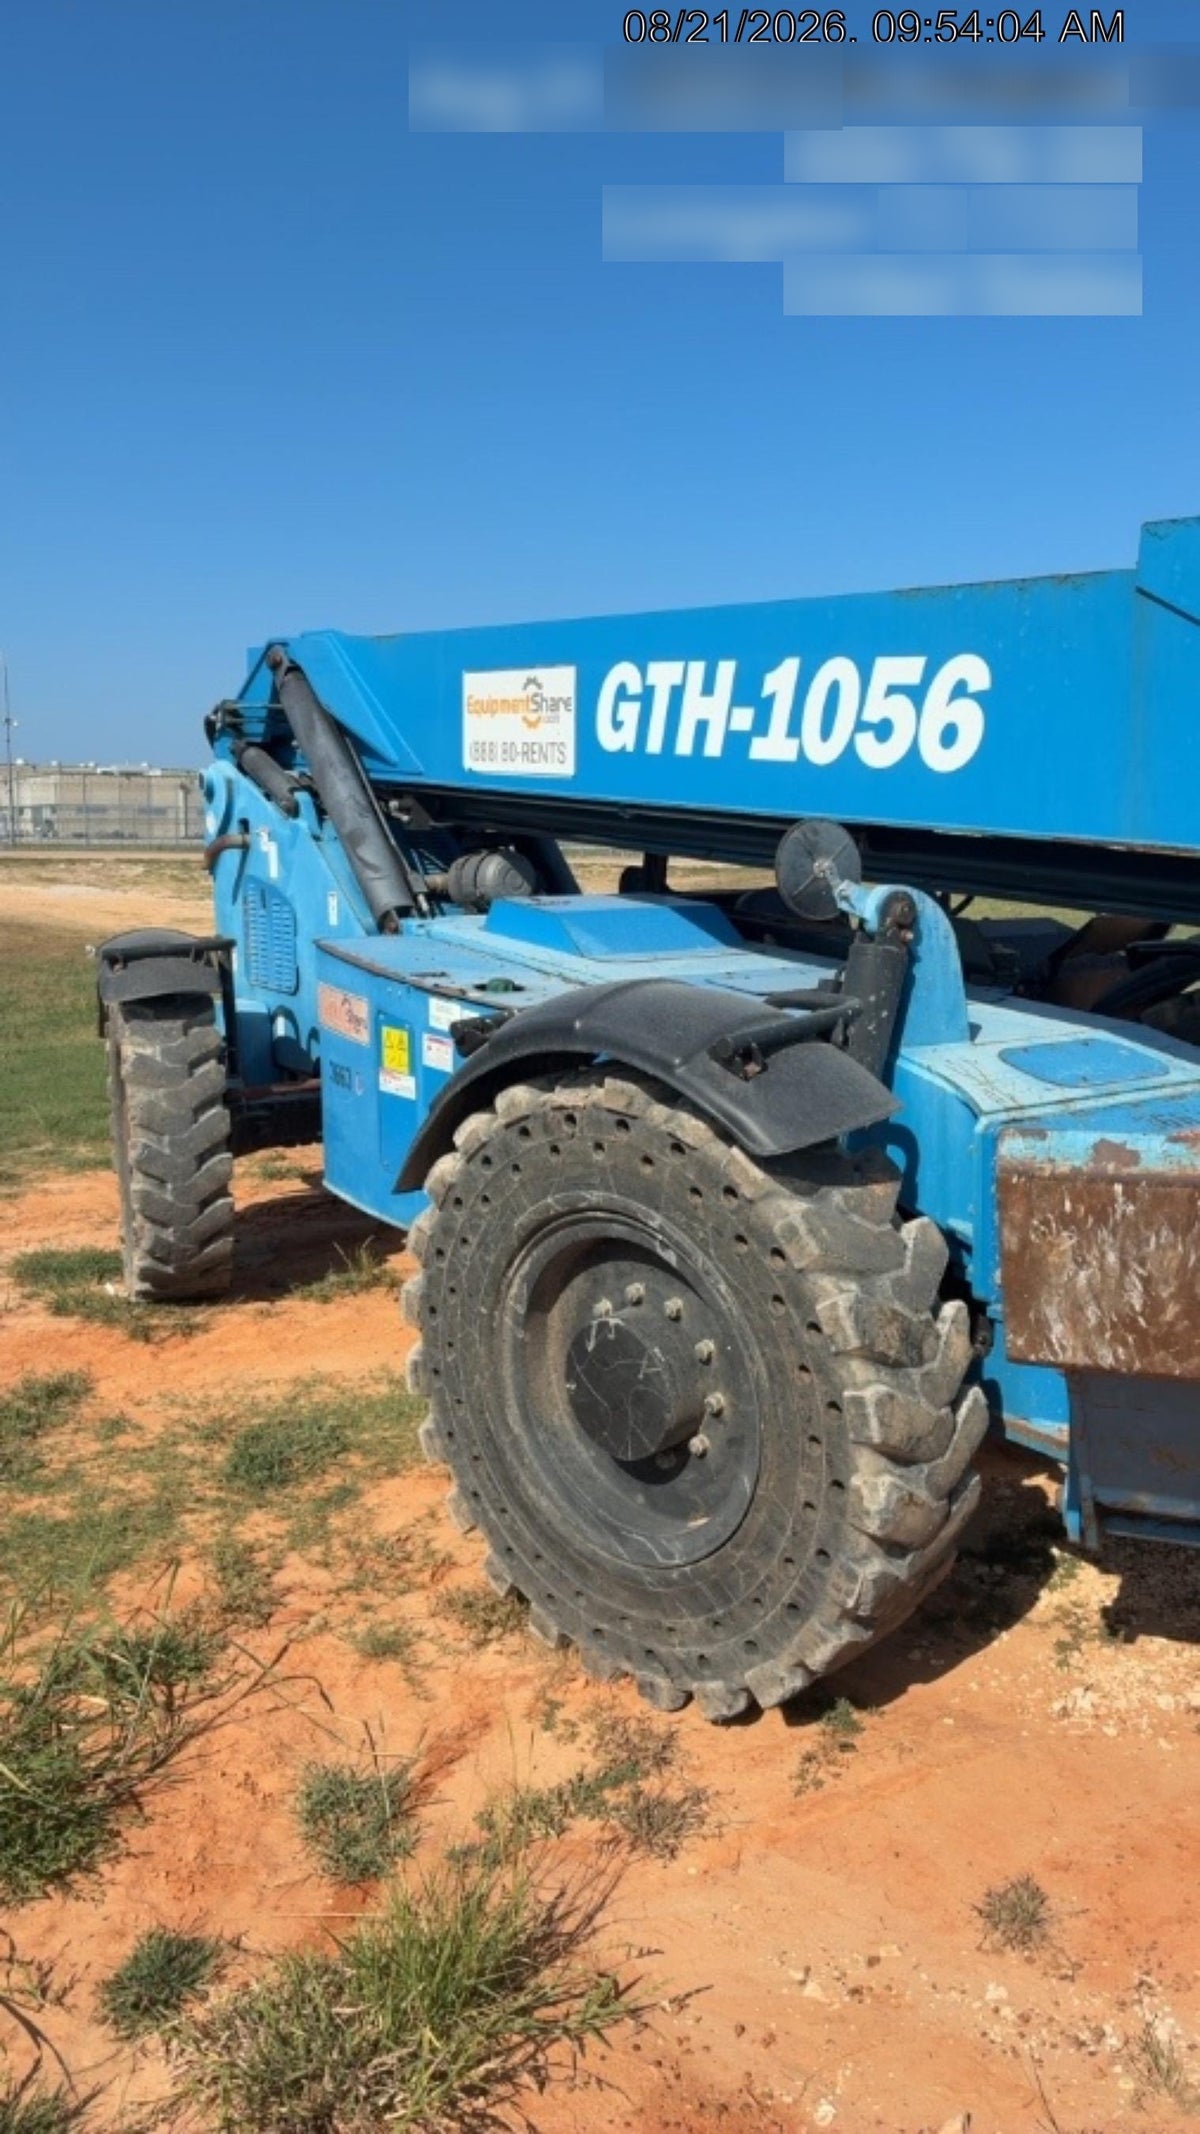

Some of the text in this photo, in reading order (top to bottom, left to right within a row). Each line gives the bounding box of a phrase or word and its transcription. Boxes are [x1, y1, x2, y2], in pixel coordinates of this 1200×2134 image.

[467, 692, 572, 718] EquipmentShare
[595, 653, 992, 773] GTH-1056
[501, 741, 567, 765] 80-RENTS
